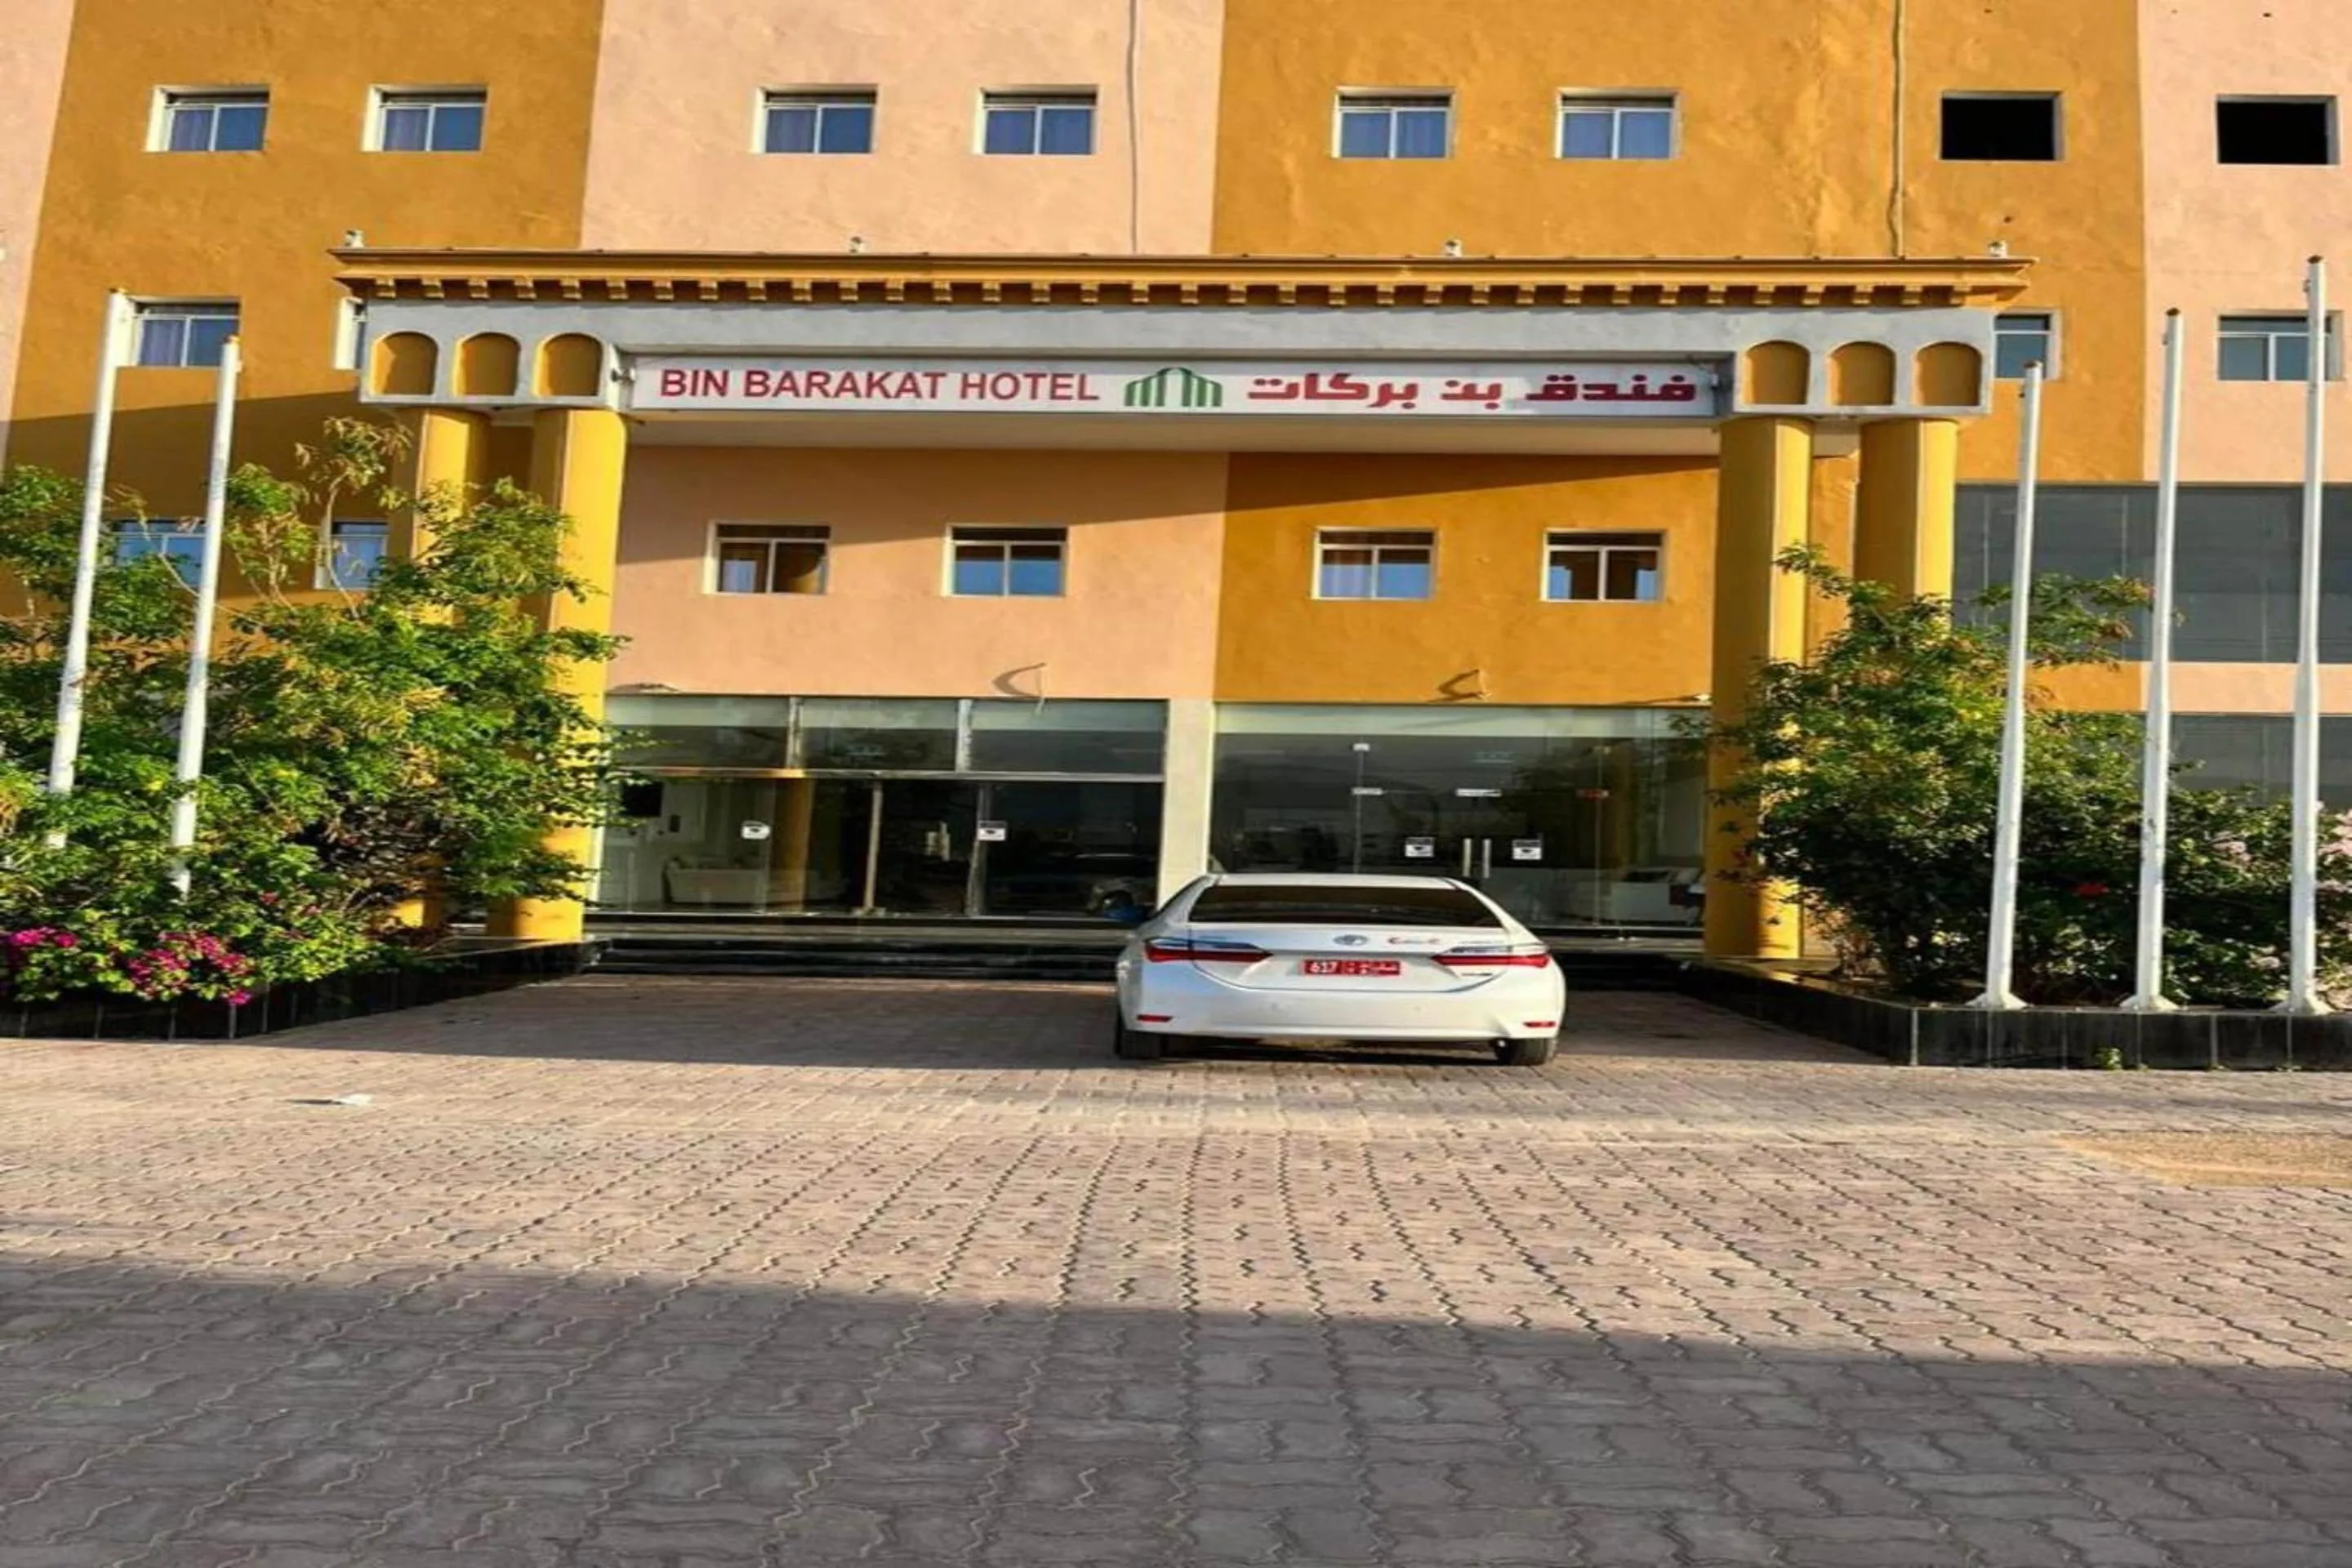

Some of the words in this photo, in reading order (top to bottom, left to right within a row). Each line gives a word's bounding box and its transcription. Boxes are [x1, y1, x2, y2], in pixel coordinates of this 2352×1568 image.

[660, 368, 729, 398] BIN
[742, 370, 947, 399] BARAKAT
[959, 372, 1100, 401] HOTEL
[1246, 372, 1419, 408] بركات
[1438, 379, 1502, 410] بن
[1525, 374, 1696, 402] فندق
